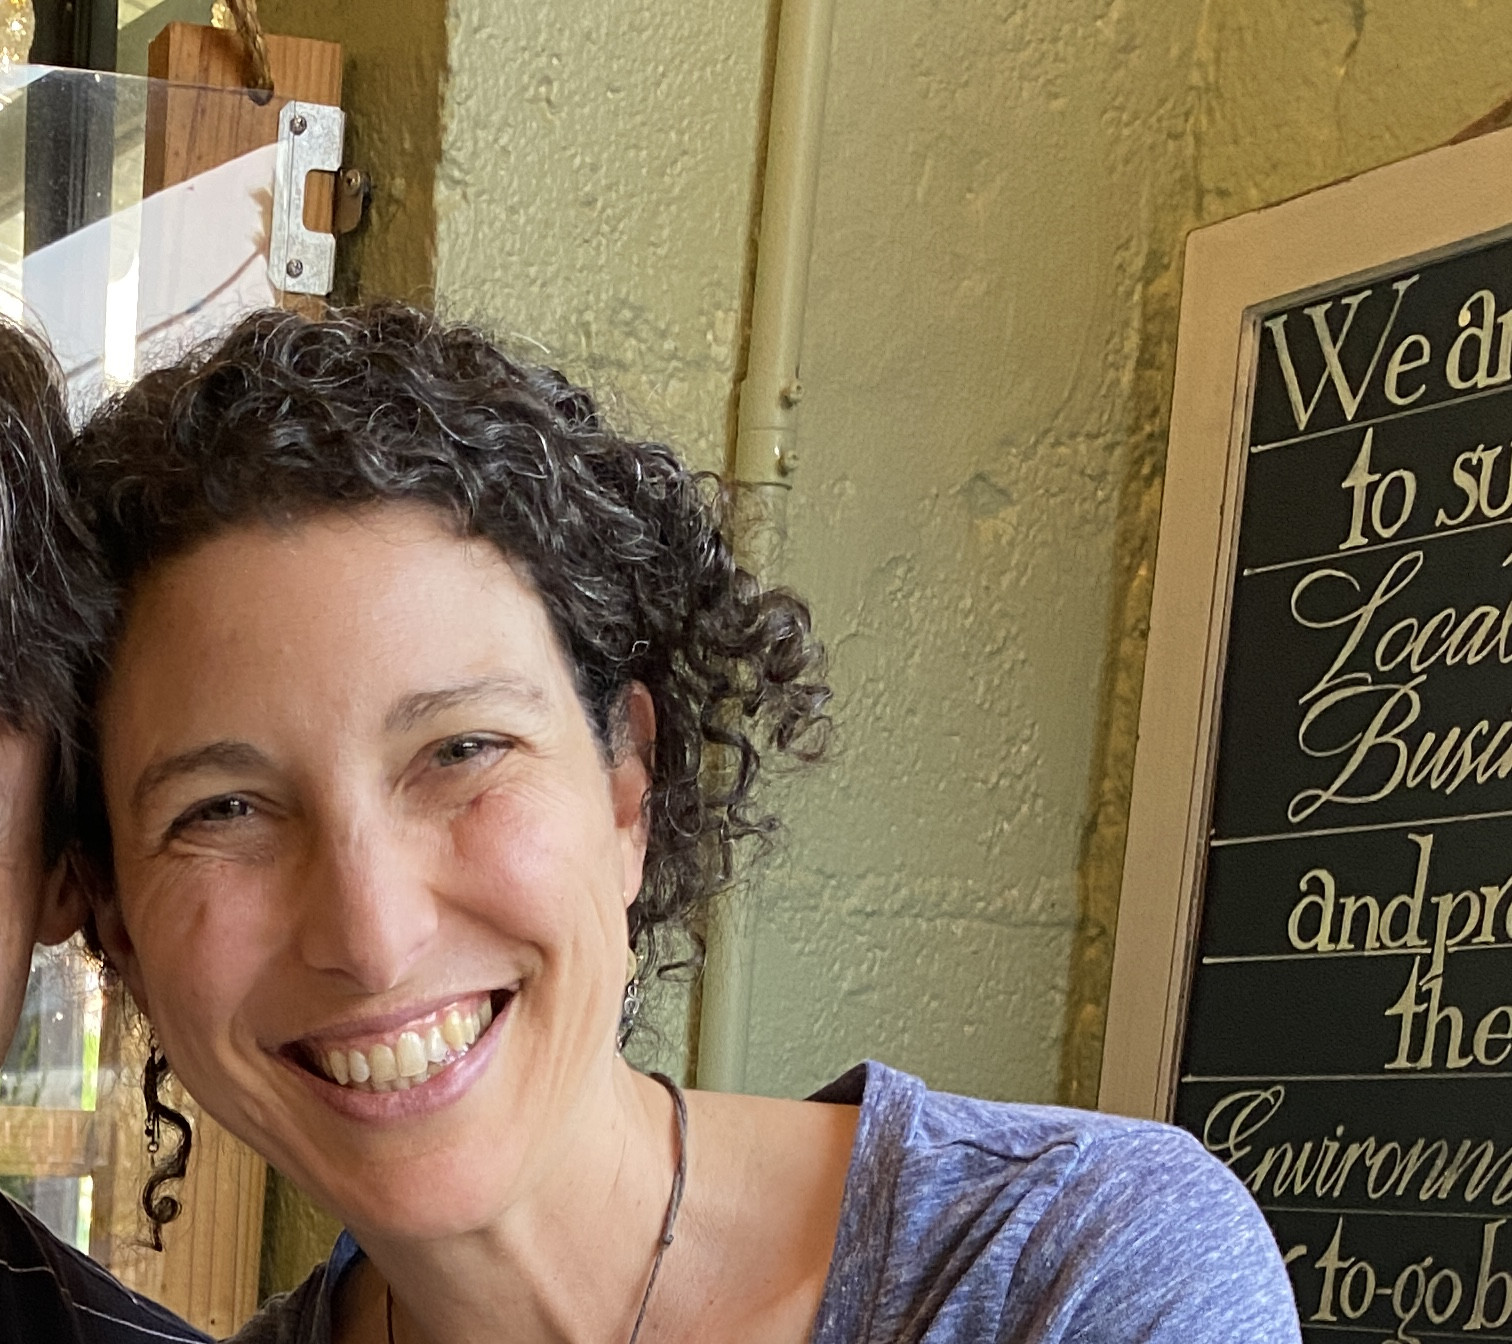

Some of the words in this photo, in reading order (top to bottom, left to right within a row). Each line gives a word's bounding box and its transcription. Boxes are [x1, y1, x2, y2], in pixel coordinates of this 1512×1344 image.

[1264, 274, 1431, 431] We
[1445, 289, 1512, 389] ar
[1338, 427, 1417, 549] to
[1435, 443, 1512, 527] su
[1287, 673, 1512, 823] Busi
[1287, 833, 1434, 952] and
[1419, 876, 1512, 986] pr
[1384, 955, 1512, 1069] the
[1203, 1084, 1512, 1207] Environm
